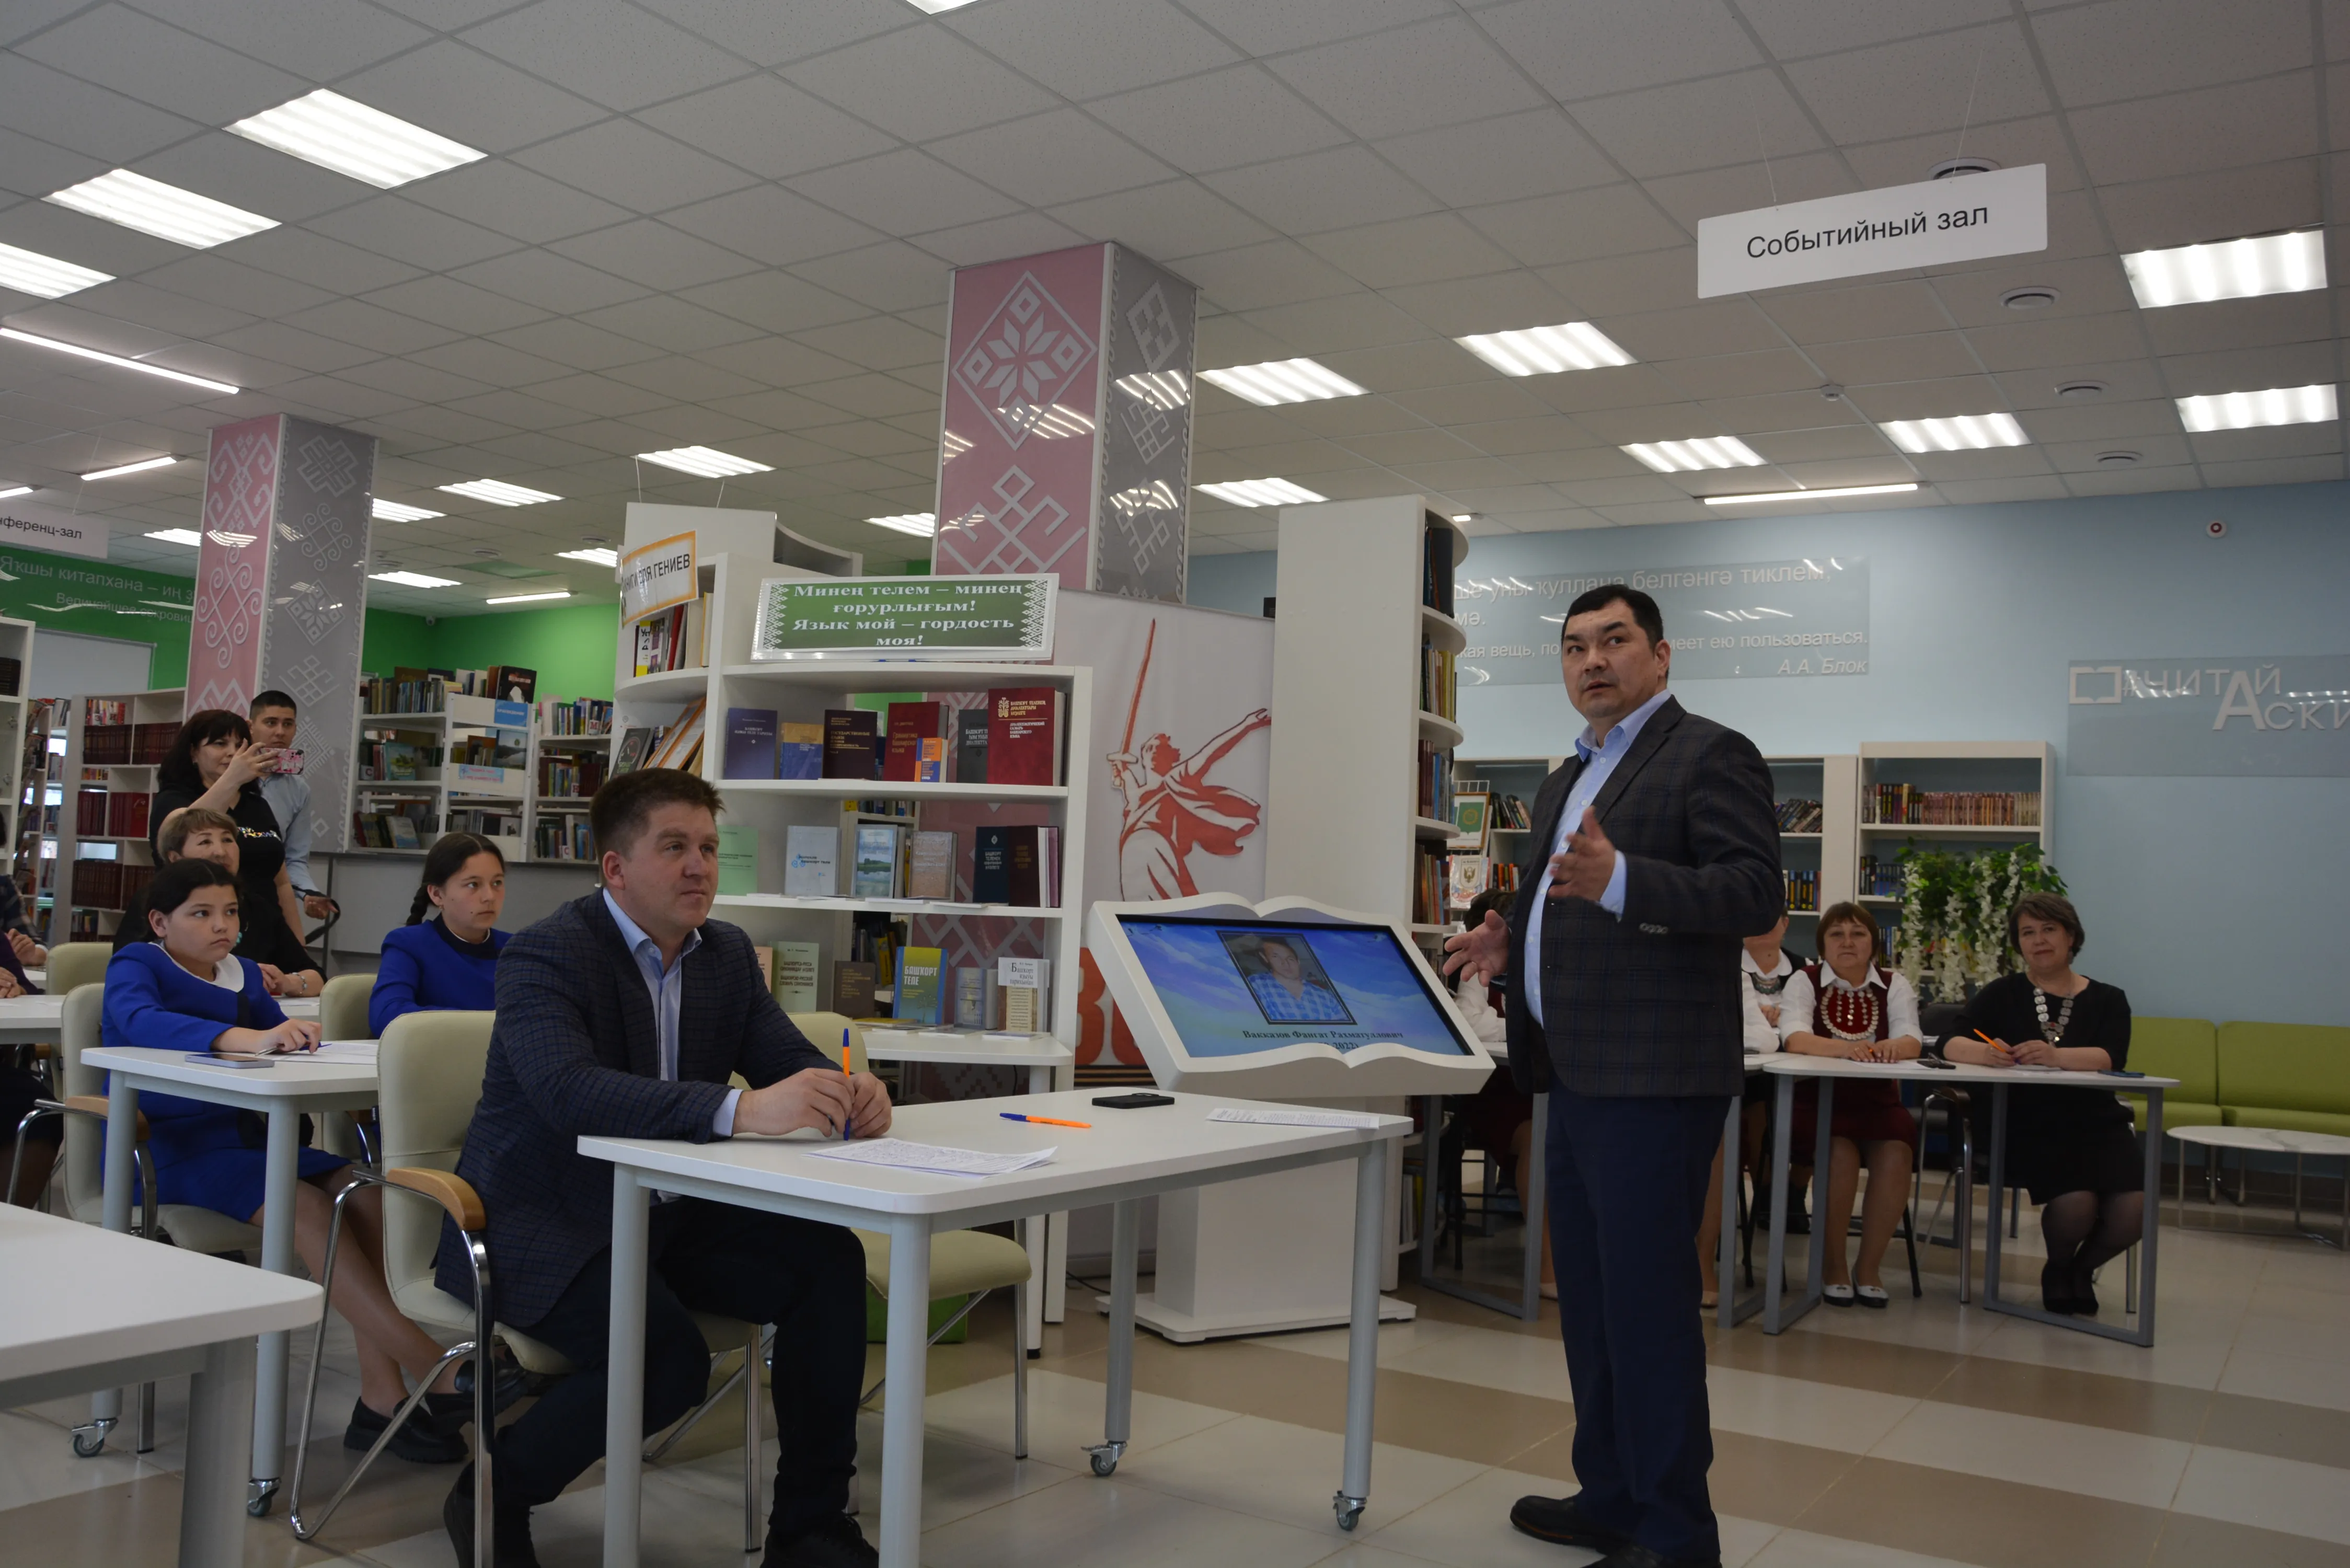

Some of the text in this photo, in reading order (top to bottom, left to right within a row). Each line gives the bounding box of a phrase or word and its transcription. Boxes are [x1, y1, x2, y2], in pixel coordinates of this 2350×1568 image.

[1747, 206, 1988, 258] Событийный зал
[653, 554, 690, 579] ГЕНИЕВ
[1633, 570, 1732, 591] белгәнгә
[794, 585, 863, 597] Минең
[870, 585, 930, 595] телем
[955, 584, 1023, 595] минең
[792, 619, 850, 630] Язык
[856, 618, 895, 630] мой
[920, 619, 1015, 631] гордость
[1455, 612, 1486, 627] мә.
[876, 635, 924, 646] моя!
[1455, 647, 1485, 659] кая
[1491, 644, 1535, 658] вещь,
[1710, 636, 1734, 650] ею
[1741, 631, 1869, 649] пользоваться.
[1778, 658, 1868, 675] А.А. Блок
[1242, 1030, 1403, 1040] Вакказов Фангат Рахматуллович
